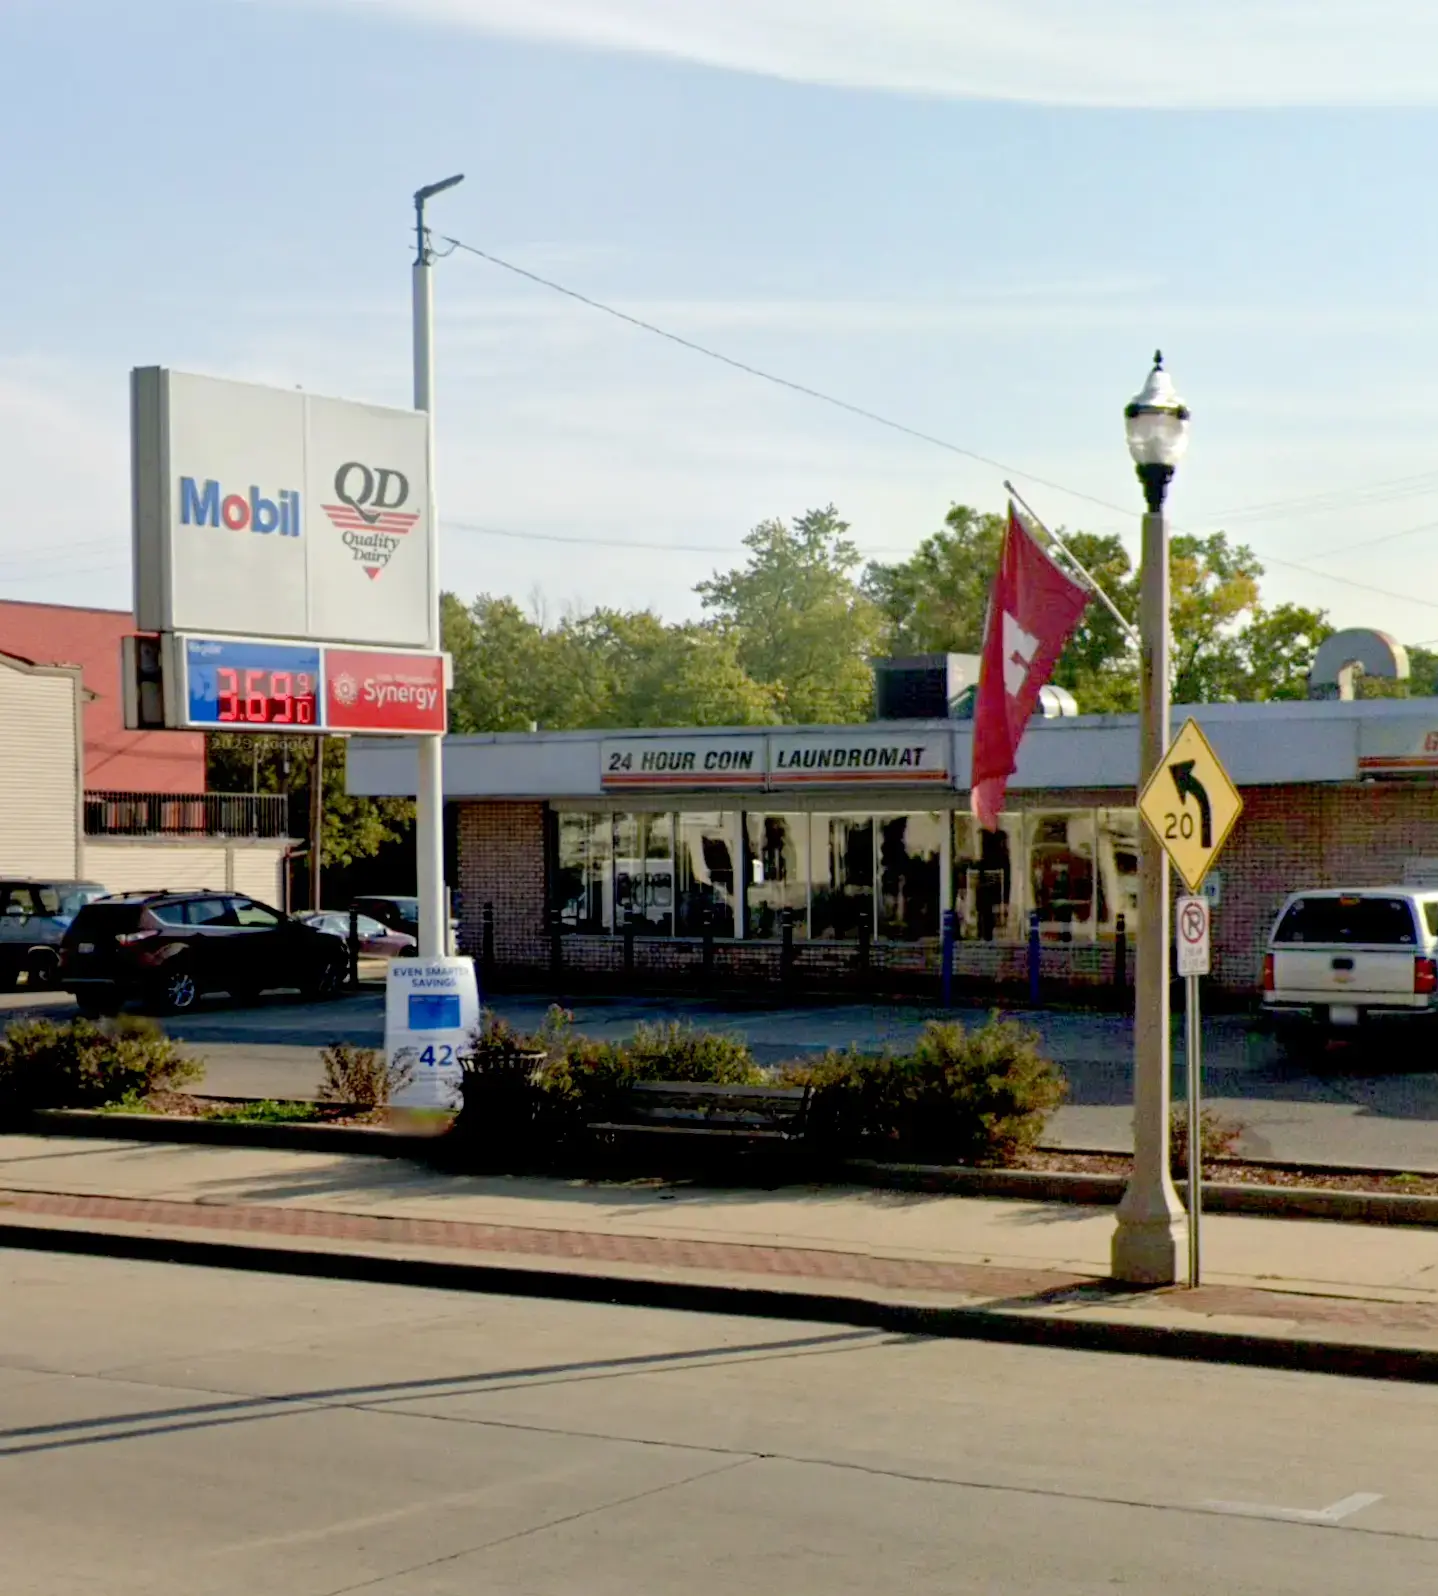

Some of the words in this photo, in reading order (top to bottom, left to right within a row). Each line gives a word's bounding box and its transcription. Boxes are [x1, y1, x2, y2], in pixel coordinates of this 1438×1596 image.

[334, 461, 410, 525] QD
[180, 476, 300, 538] Mobil
[341, 530, 401, 554] Quality
[352, 547, 393, 569] Dairy
[217, 667, 292, 722] 3.69
[363, 677, 438, 711] Synergy
[608, 752, 632, 770] 24
[641, 751, 696, 770] HOUR
[704, 750, 753, 770] COIN
[776, 747, 925, 768] LAUNDROMAT
[1164, 812, 1194, 839] 20
[393, 967, 423, 977] EVEN
[411, 978, 457, 988] SAVINGS
